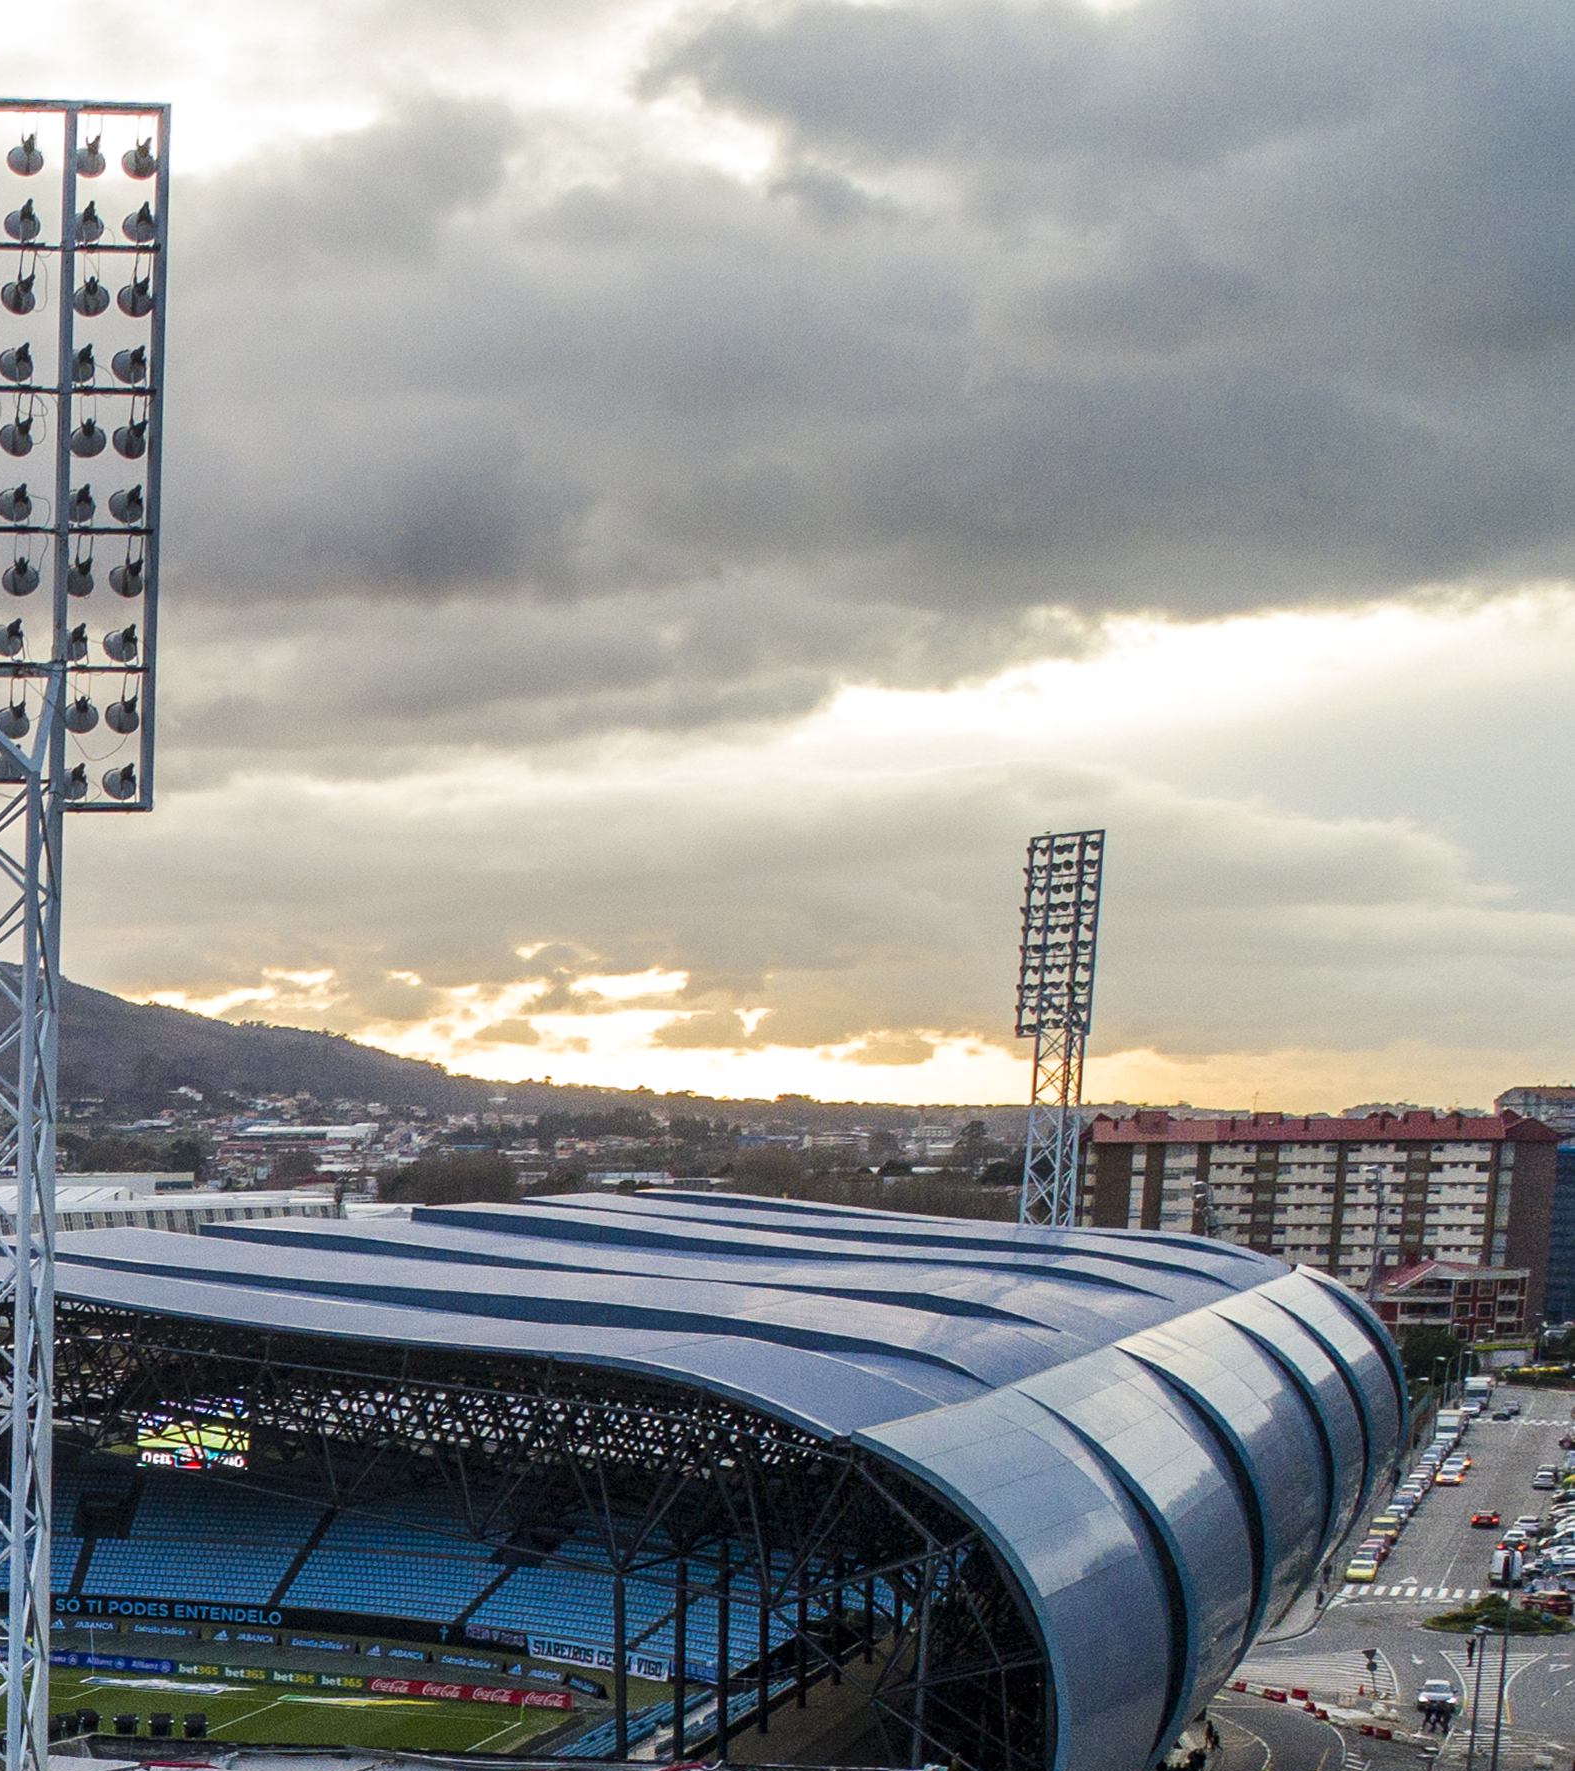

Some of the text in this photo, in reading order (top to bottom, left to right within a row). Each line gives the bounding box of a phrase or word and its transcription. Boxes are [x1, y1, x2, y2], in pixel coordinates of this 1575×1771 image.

[55, 1596, 282, 1626] SÓ TI PODES ENTENDELO
[178, 1663, 219, 1675] bet365
[225, 1667, 266, 1680] bet365
[273, 1671, 315, 1684] bet365
[321, 1675, 363, 1688] bet365
